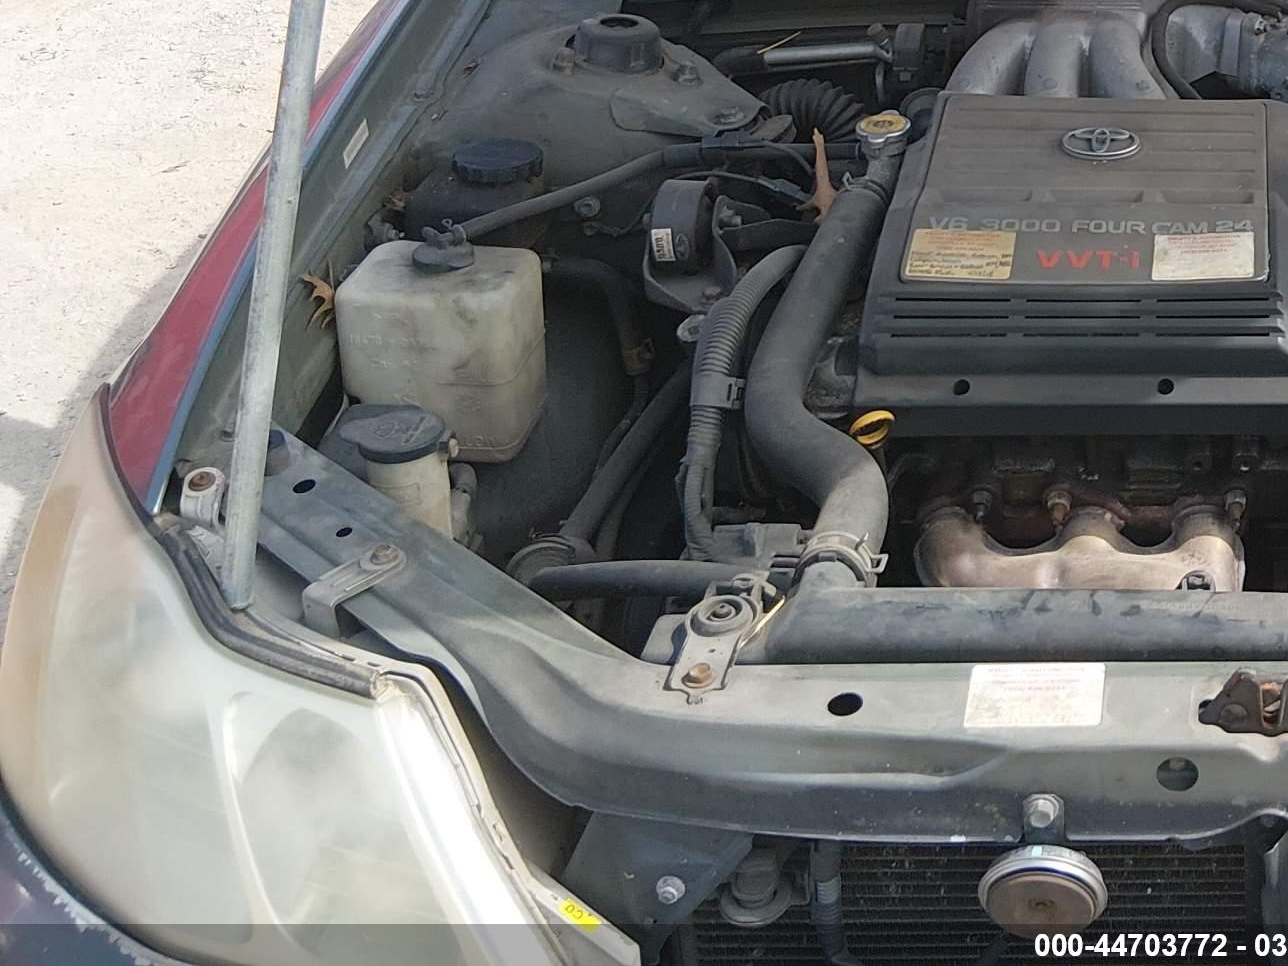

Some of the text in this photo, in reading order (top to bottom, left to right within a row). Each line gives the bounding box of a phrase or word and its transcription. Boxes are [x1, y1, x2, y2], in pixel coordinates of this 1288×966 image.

[929, 217, 1254, 234] V6 3000 FOUR CAM 24
